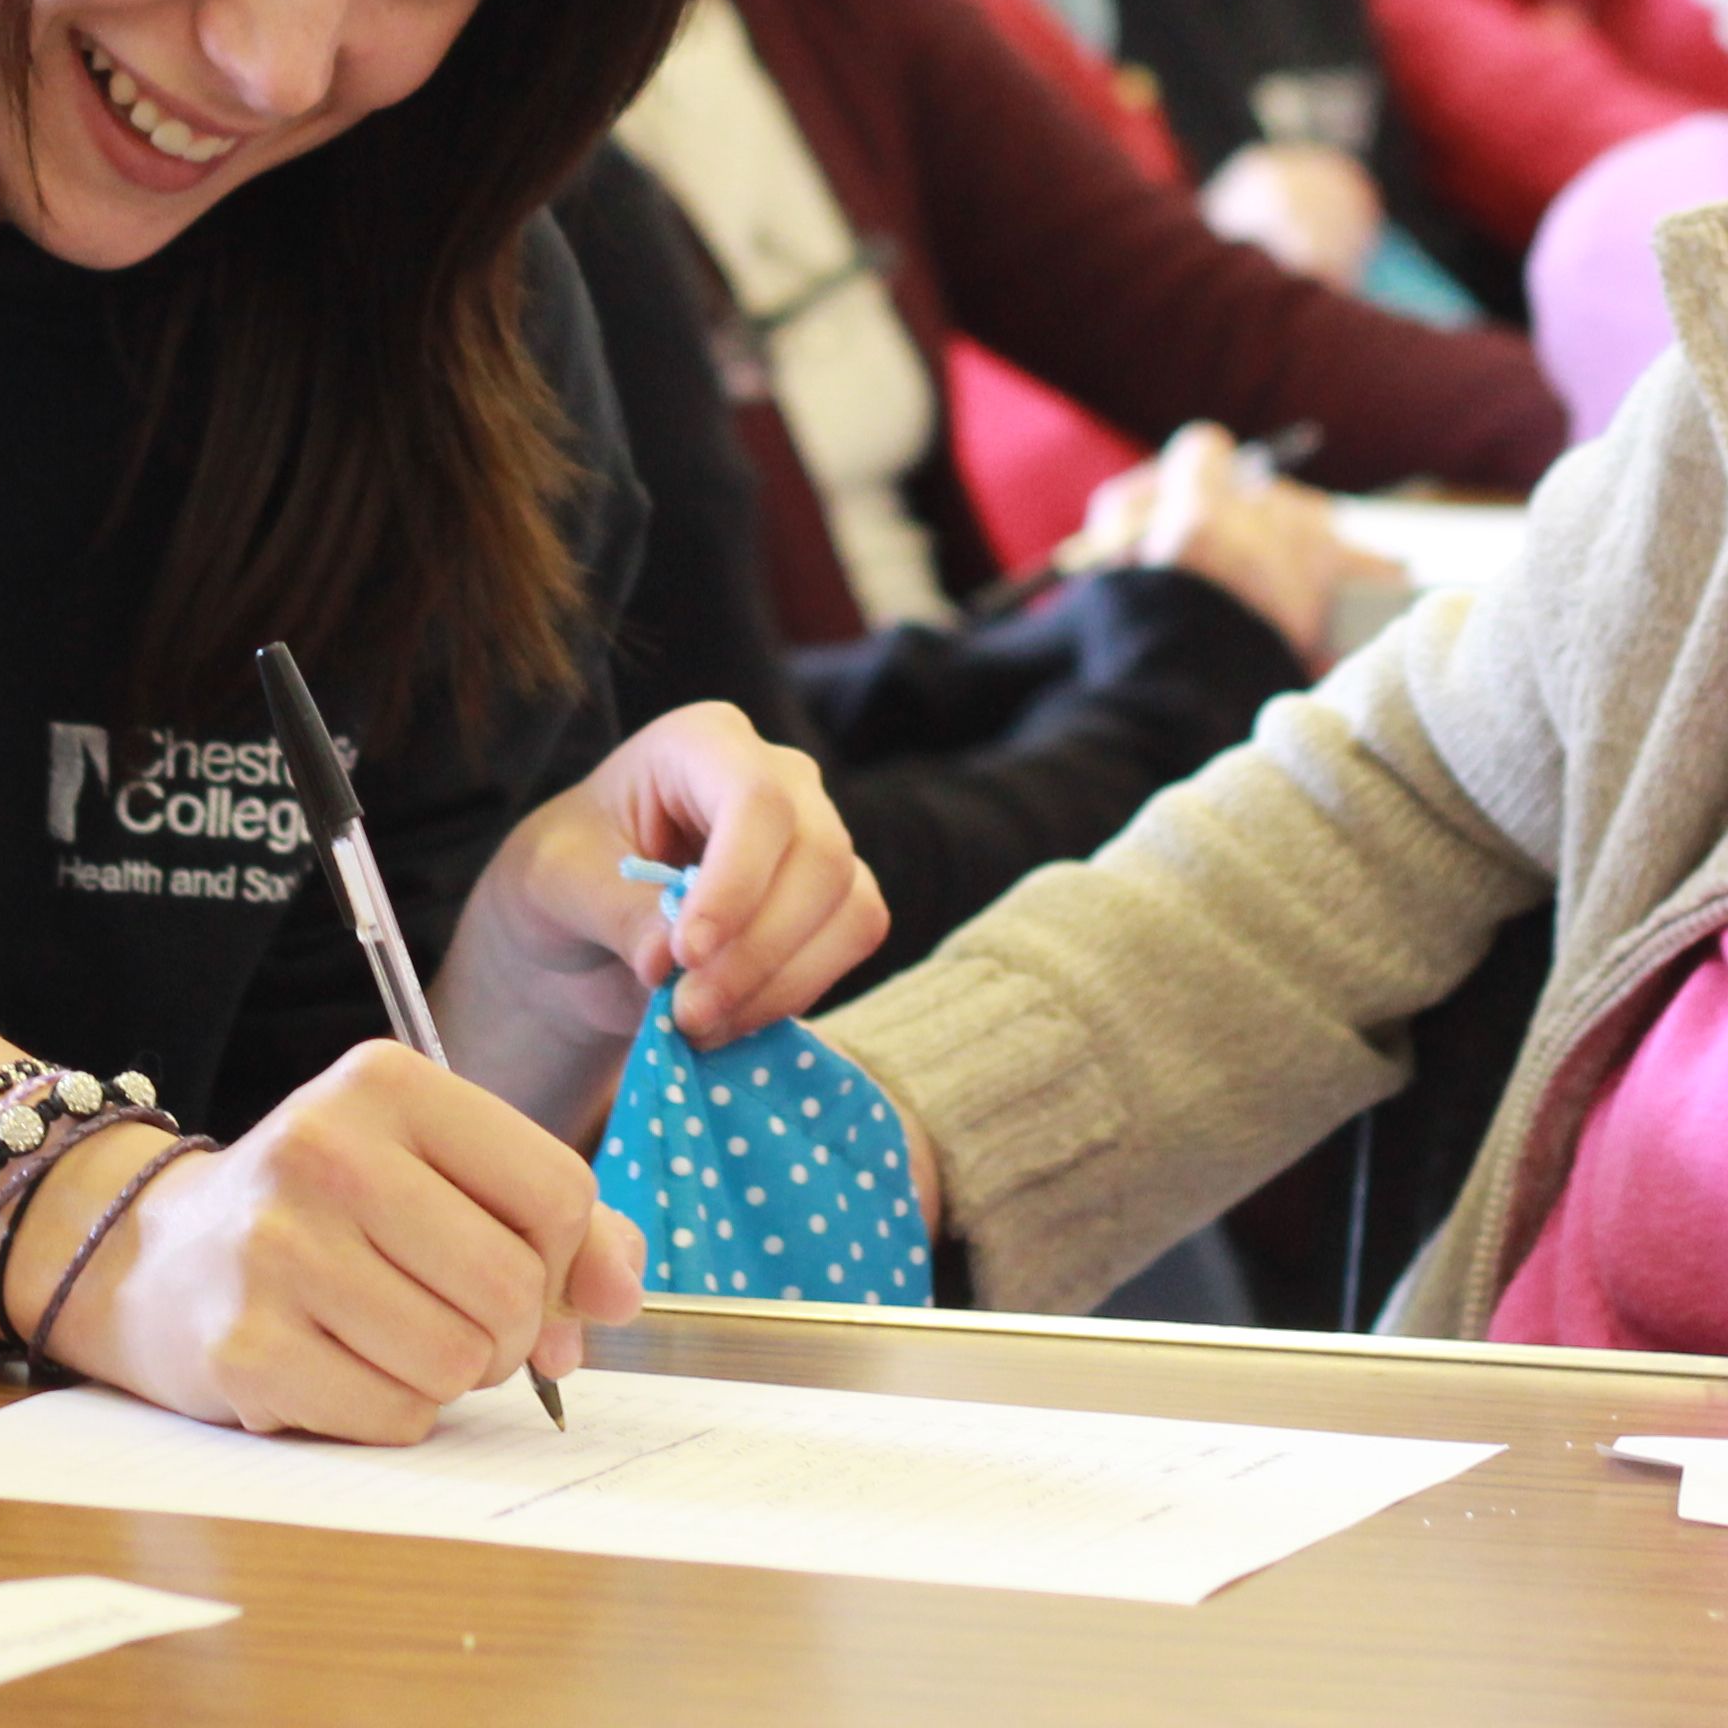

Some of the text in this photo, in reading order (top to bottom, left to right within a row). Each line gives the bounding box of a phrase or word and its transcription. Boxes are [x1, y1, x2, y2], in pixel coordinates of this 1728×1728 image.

[138, 728, 359, 789] Chest
[115, 779, 313, 855] Colleg
[58, 855, 163, 896] Health
[169, 865, 236, 900] and
